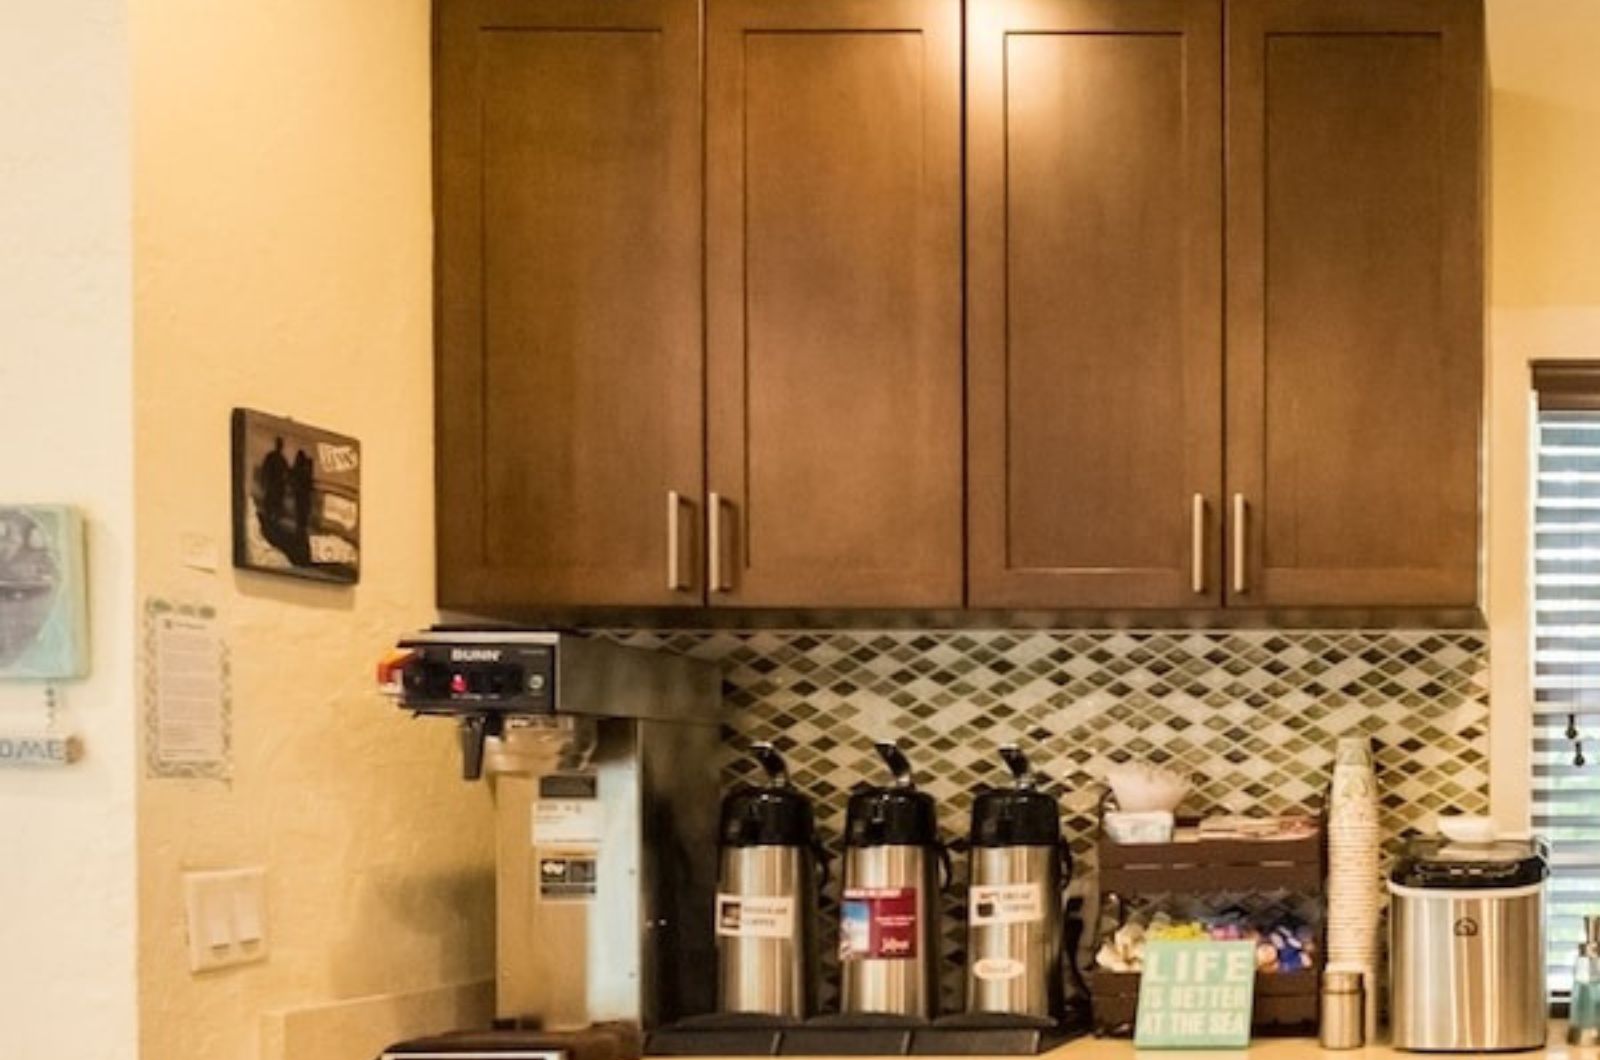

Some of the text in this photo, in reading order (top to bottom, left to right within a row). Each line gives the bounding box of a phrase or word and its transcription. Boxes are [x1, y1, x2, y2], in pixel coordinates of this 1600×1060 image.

[451, 648, 503, 662] BUNN
[1143, 950, 1251, 983] LIFE
[1142, 984, 1250, 1010] IS BETTER
[1141, 1011, 1247, 1036] AT THE SEA
